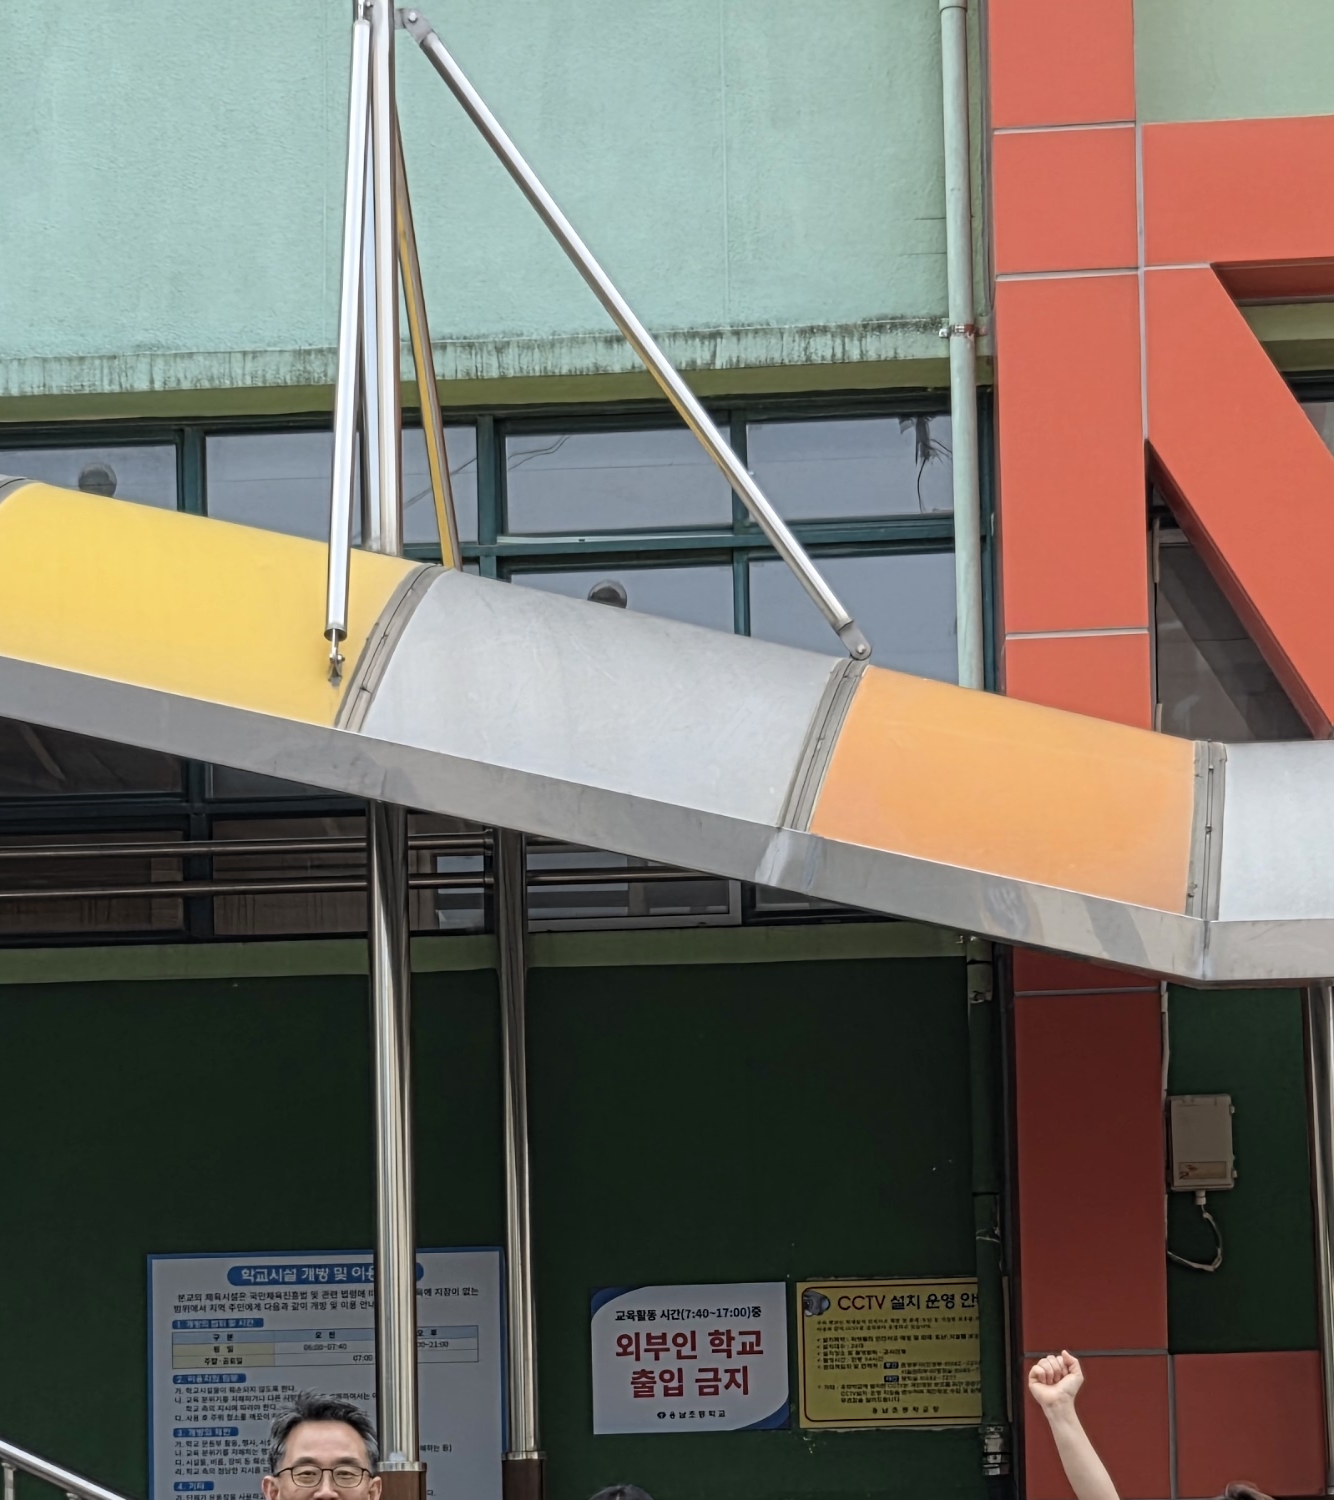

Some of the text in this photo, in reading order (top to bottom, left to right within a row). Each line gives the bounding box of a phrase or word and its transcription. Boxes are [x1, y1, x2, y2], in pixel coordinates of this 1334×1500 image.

[241, 1268, 297, 1283] 학교시설
[301, 1268, 328, 1281] 개방
[334, 1267, 347, 1280] 및
[837, 1295, 886, 1311] CCTV
[890, 1294, 920, 1310] 설치
[926, 1293, 955, 1309] 운영
[615, 1309, 657, 1321] 교육활동
[615, 1329, 764, 1362] 외부인 학교
[630, 1365, 749, 1398] 출입 금지
